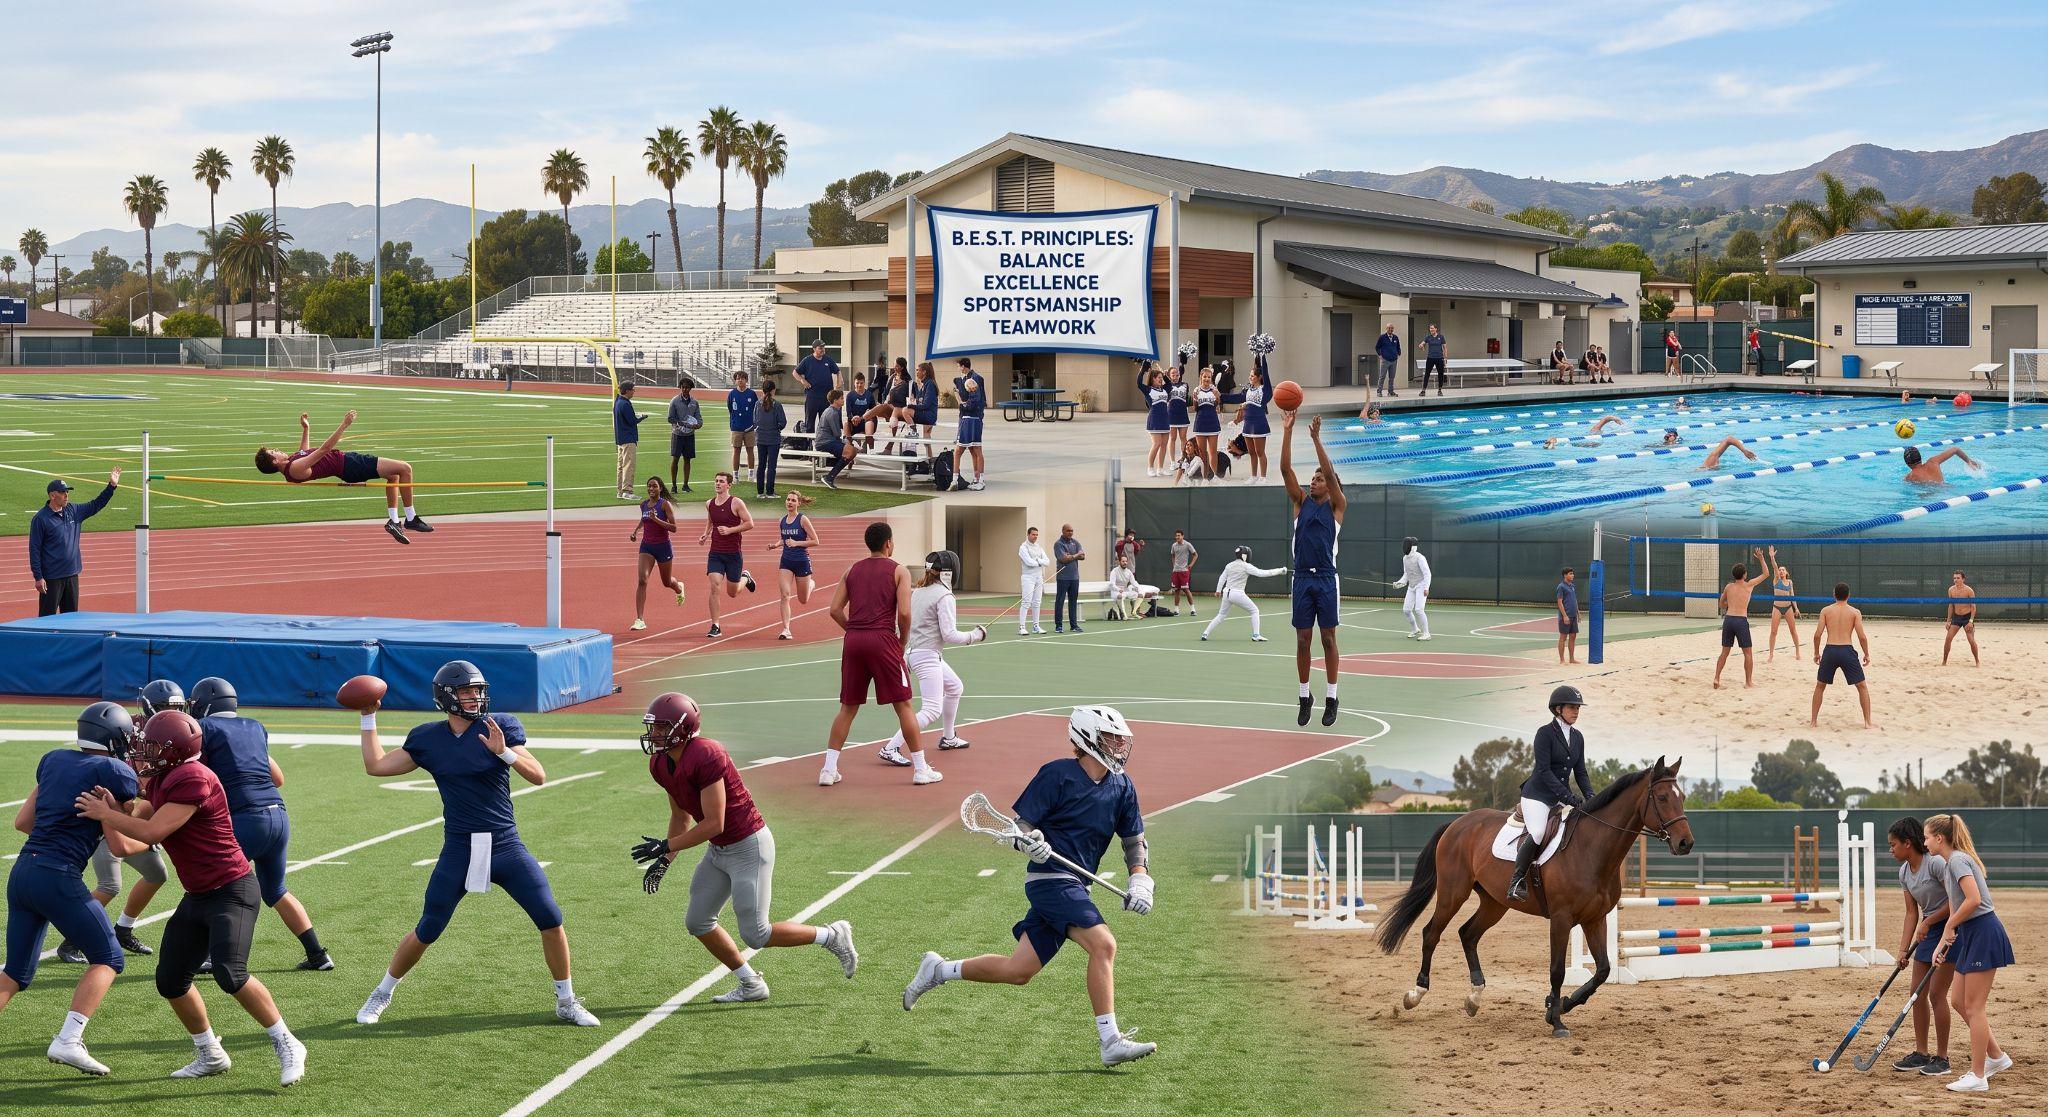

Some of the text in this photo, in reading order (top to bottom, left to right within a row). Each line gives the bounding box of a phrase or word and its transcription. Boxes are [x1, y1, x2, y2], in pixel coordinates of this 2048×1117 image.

[952, 230, 1134, 246] B.E.S.T. PRINCIPLES:
[1000, 252, 1085, 268] BALANCE
[984, 274, 1099, 290] EXCELLENCE
[963, 296, 1122, 312] SPORTSMANSHIP
[988, 319, 1096, 335] TEAMWORK
